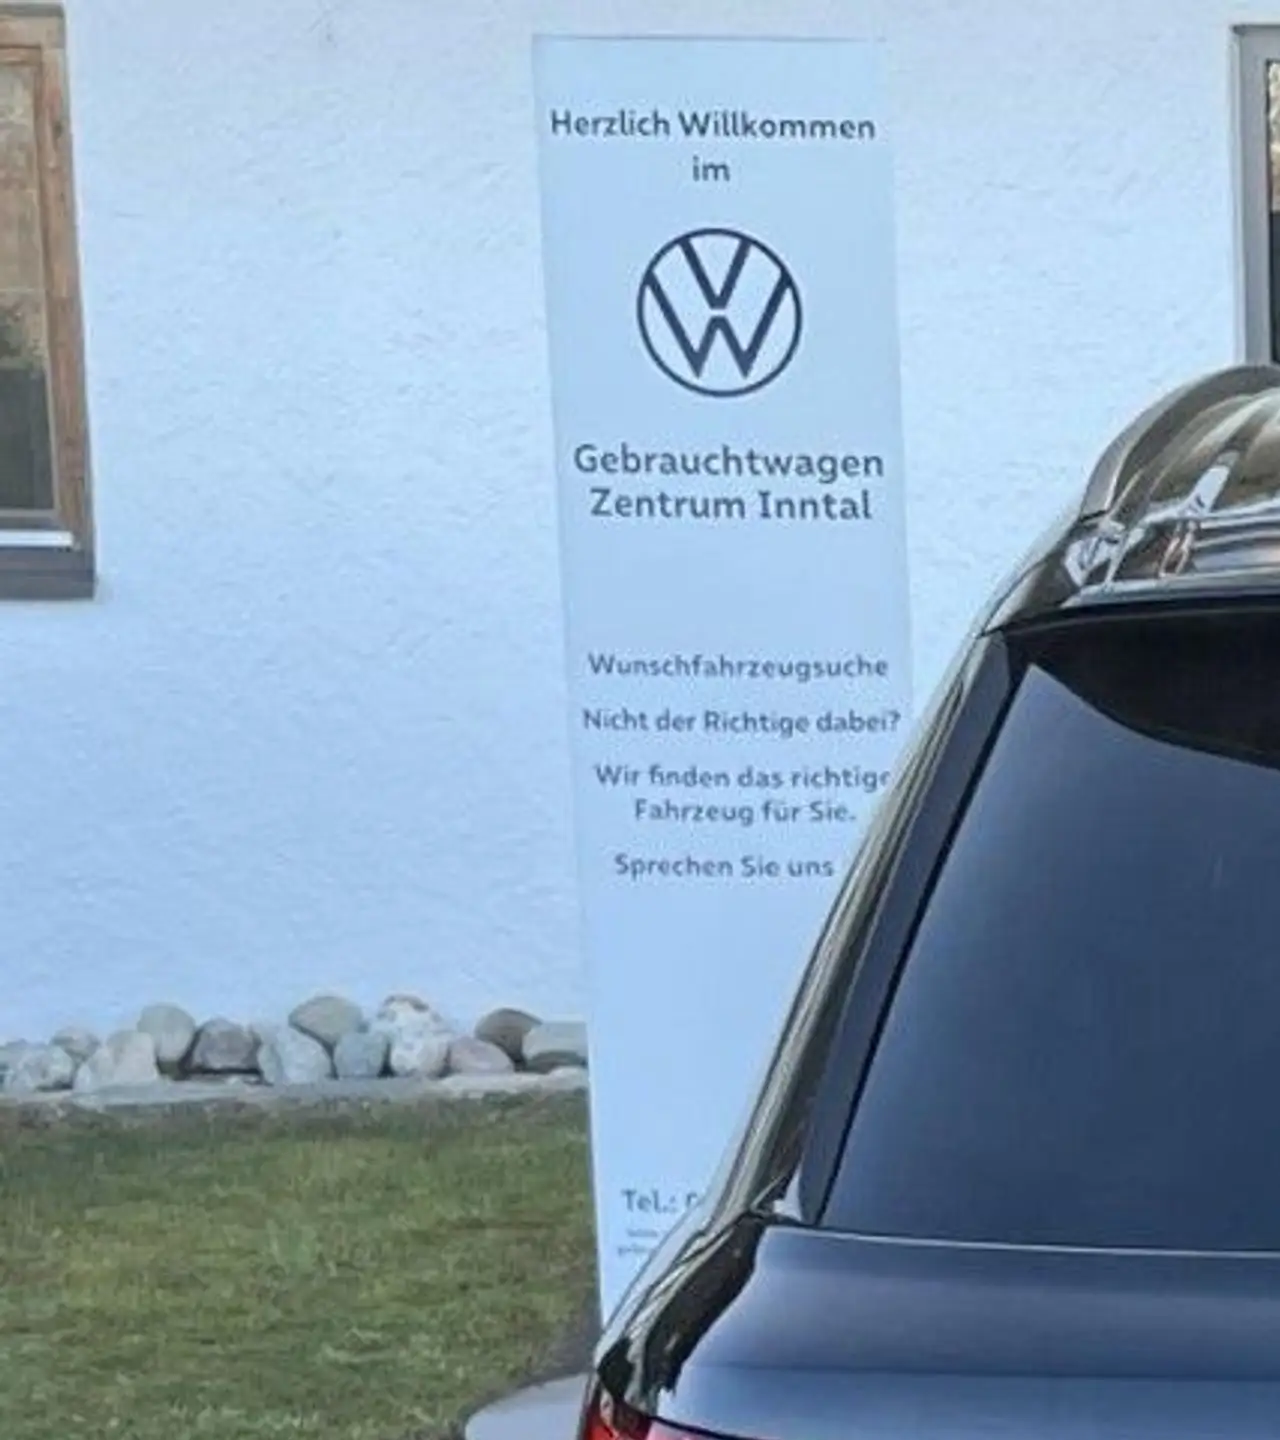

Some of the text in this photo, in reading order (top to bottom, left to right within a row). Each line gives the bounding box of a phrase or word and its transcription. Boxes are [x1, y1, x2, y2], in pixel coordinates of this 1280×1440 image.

[550, 110, 876, 140] Herzlich Willkommen
[692, 157, 731, 182] im
[637, 228, 802, 399] VW
[573, 444, 885, 484] Gebrauchtwagen
[589, 488, 873, 521] Zentrum Inntal
[588, 653, 889, 683] Wunschfahrzeugsuche
[583, 709, 901, 738] Nicht der Richtige dabei?
[594, 765, 640, 786] Wir
[649, 765, 731, 788] finden
[737, 767, 784, 790] das
[634, 800, 755, 827] Fahrzeug
[809, 802, 858, 822] Sie.
[614, 855, 834, 880] Sprechen Sie uns
